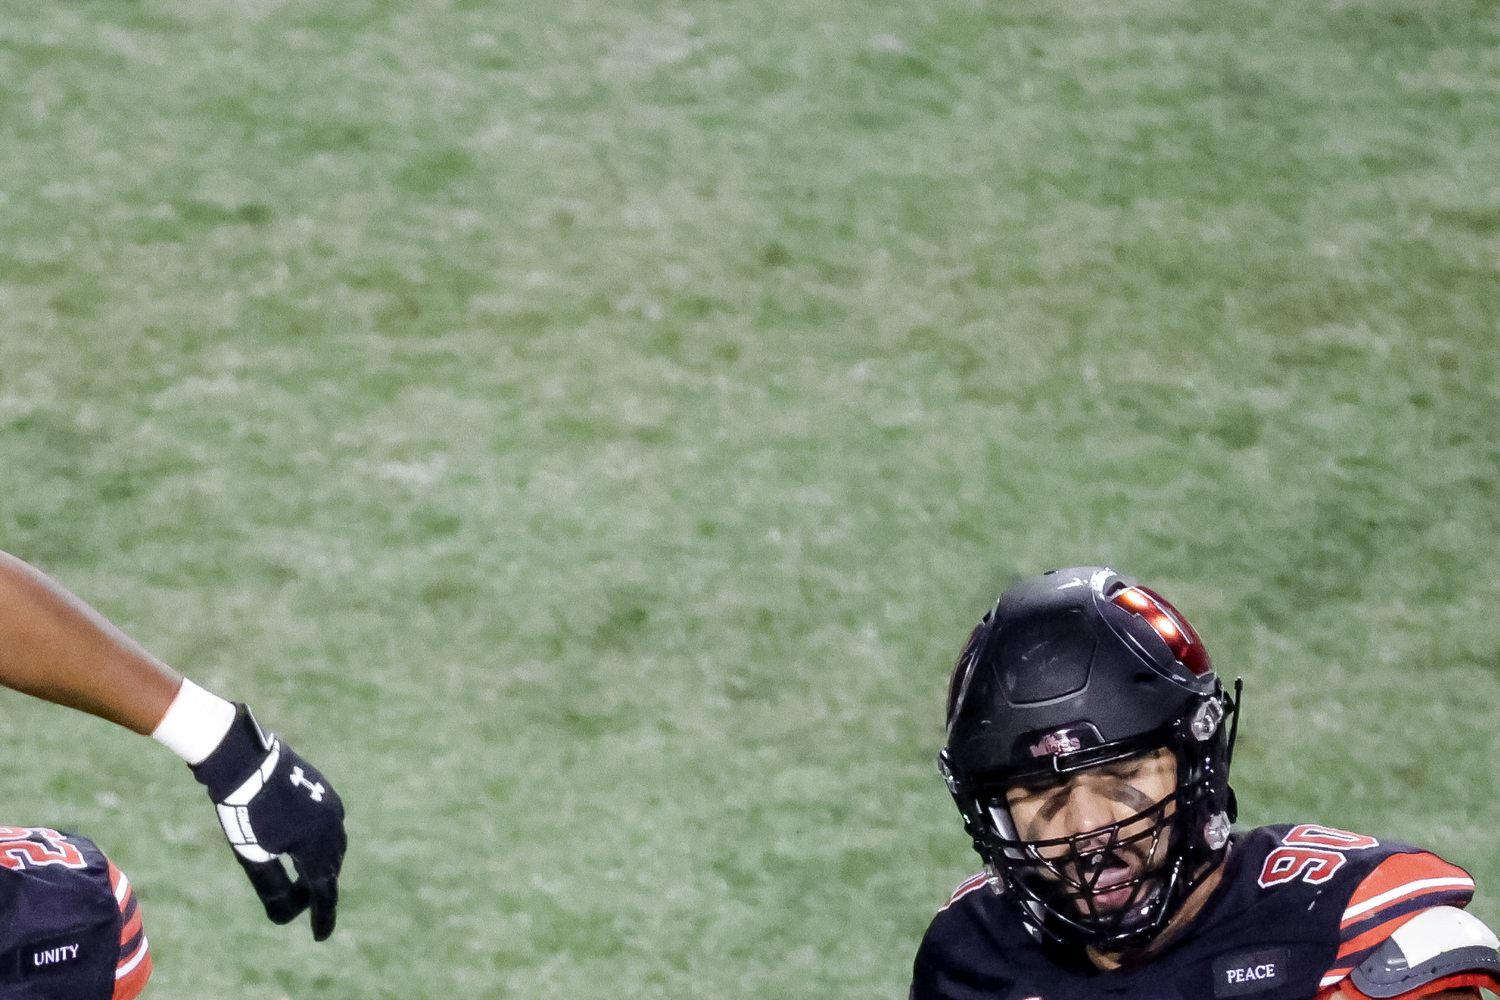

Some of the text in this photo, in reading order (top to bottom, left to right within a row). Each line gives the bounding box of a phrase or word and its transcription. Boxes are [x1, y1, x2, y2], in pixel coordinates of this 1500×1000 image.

[1257, 824, 1380, 888] 90
[33, 943, 79, 966] UNITY
[1226, 964, 1275, 984] PEACE
